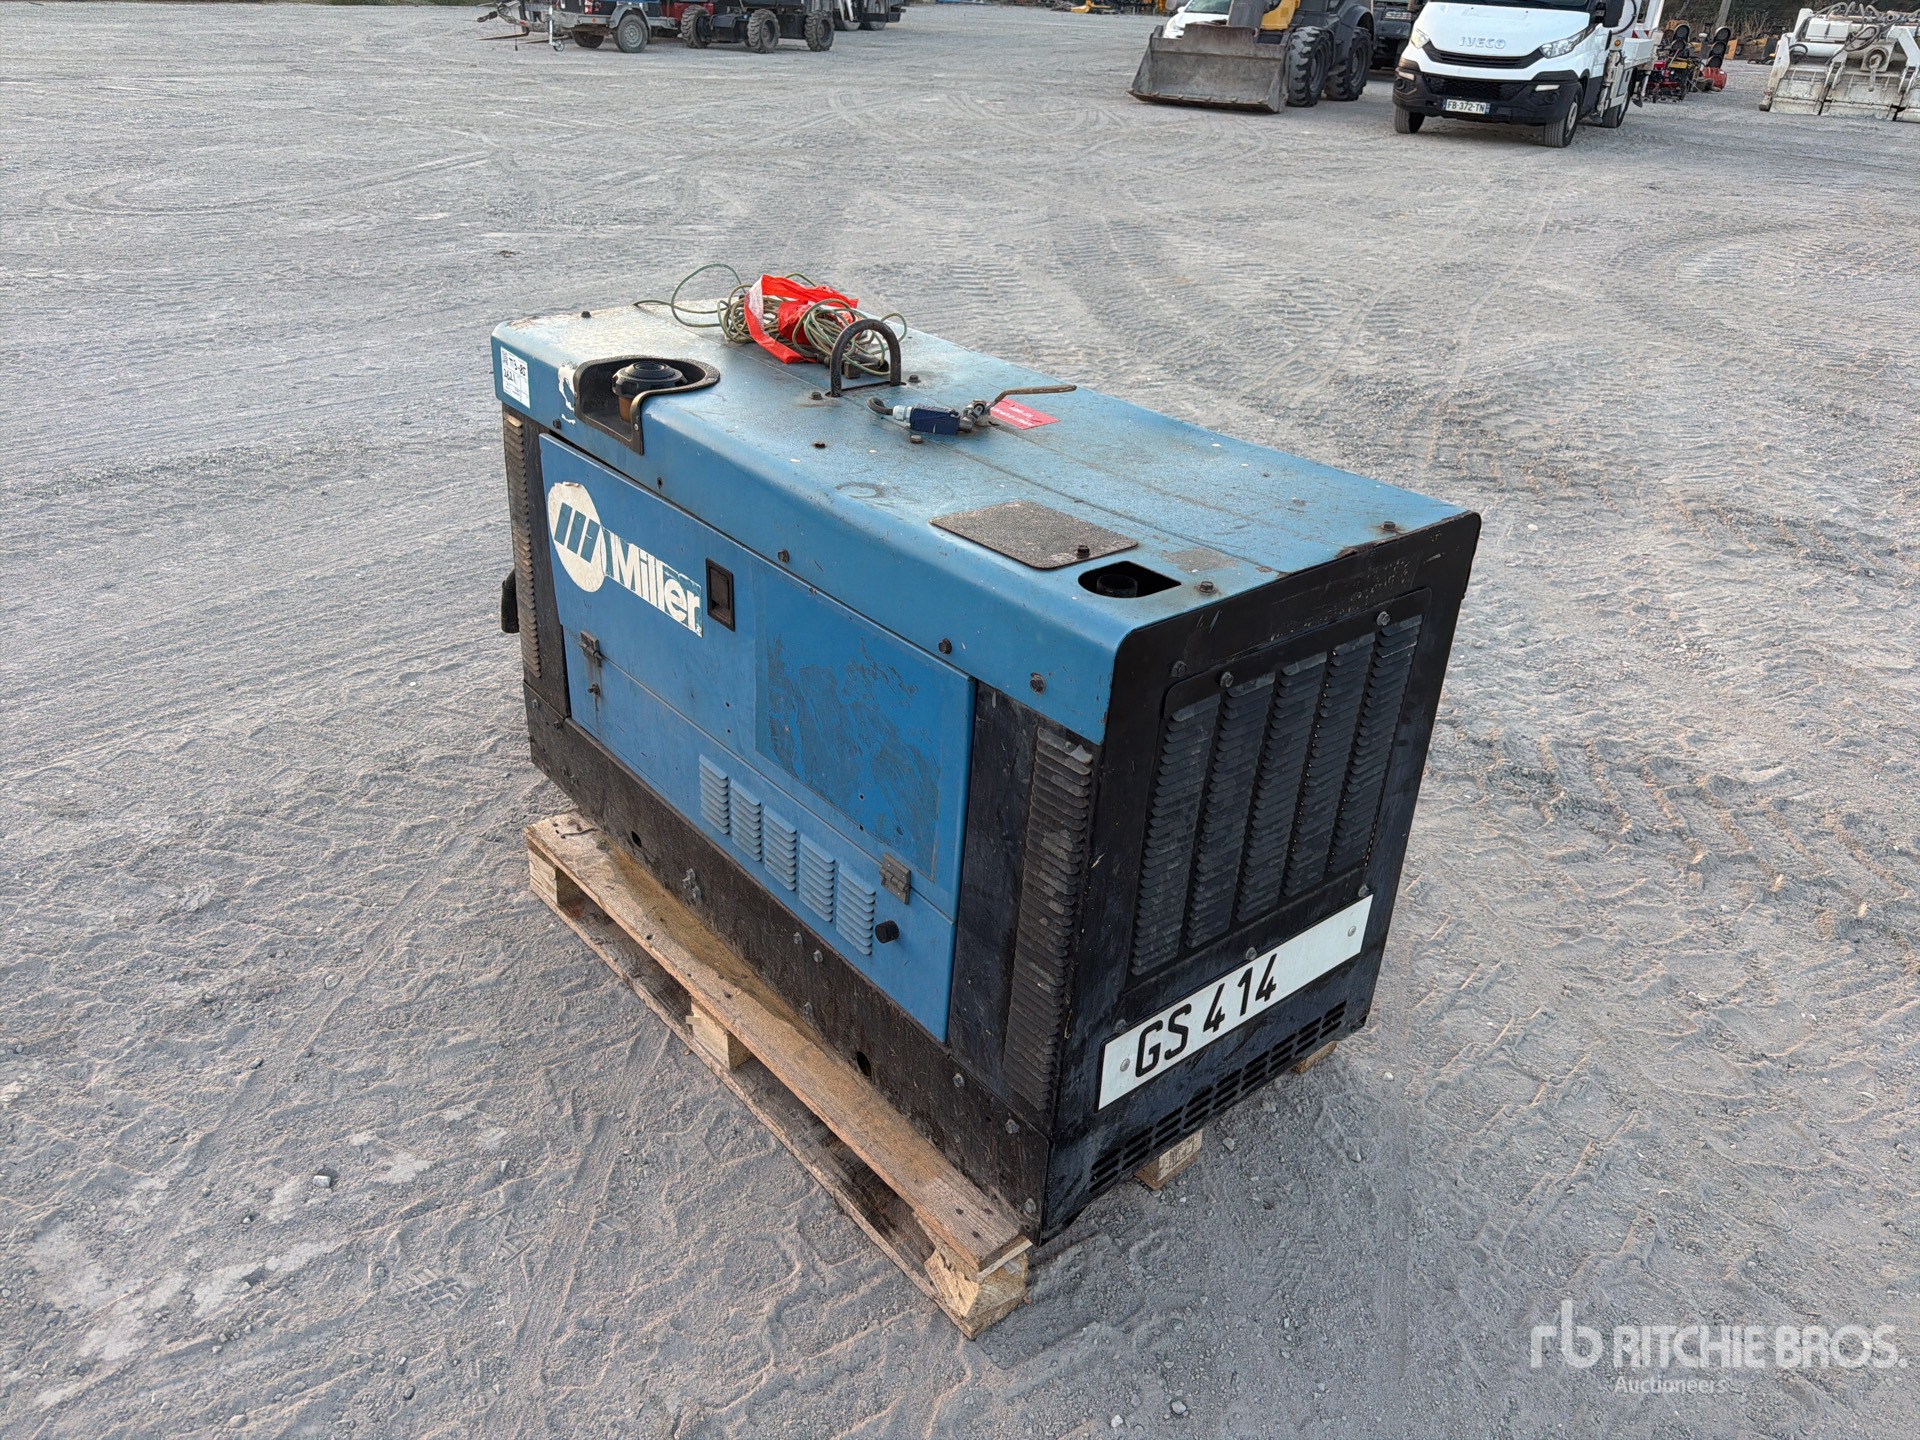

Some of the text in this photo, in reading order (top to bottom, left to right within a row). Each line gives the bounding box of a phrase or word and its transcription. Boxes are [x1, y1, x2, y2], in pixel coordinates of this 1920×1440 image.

[1459, 36, 1506, 49] IVECO
[1447, 100, 1485, 112] FB-372-TN
[1135, 1003, 1192, 1078] GS
